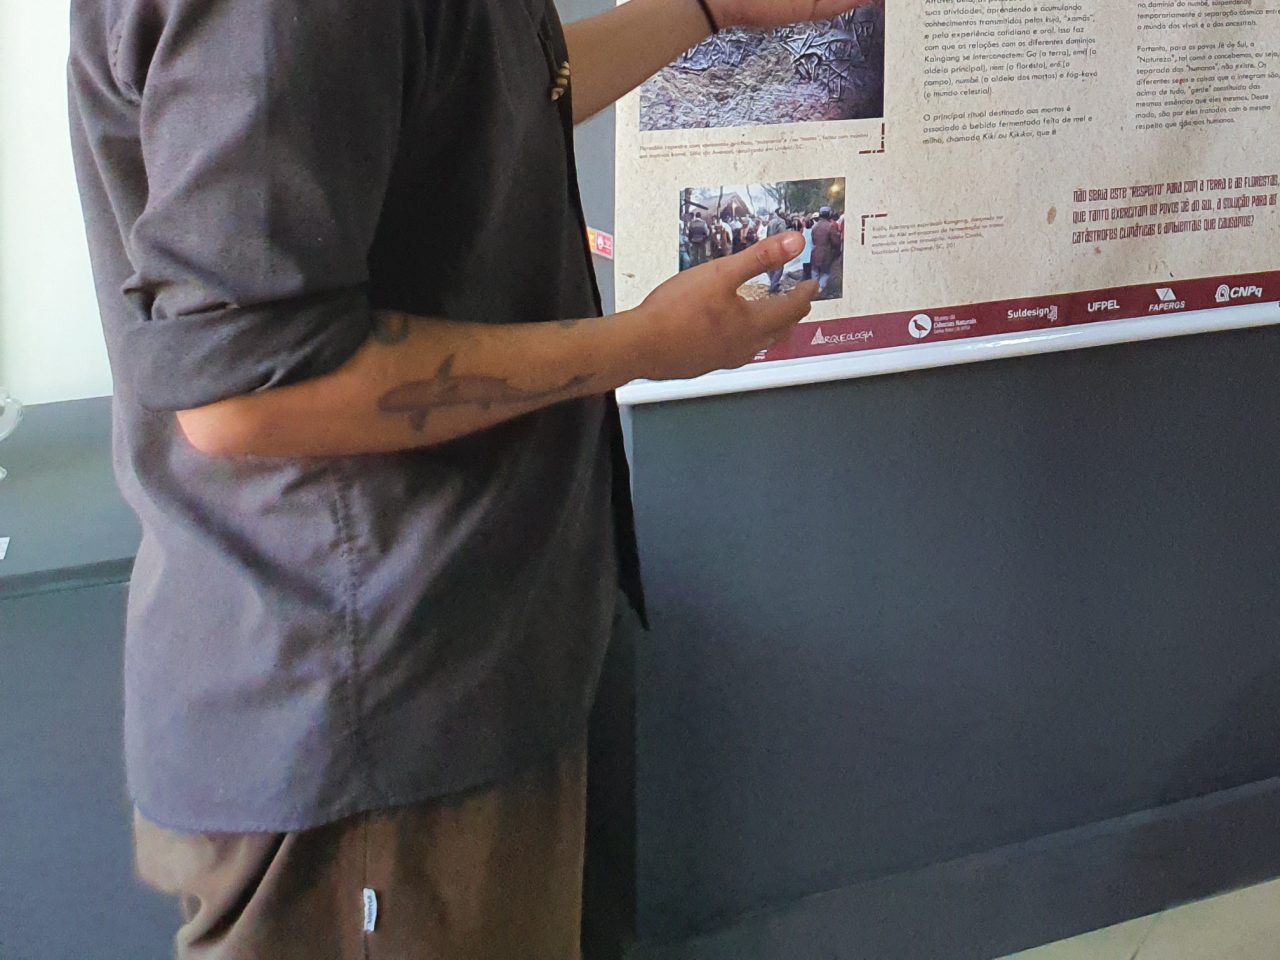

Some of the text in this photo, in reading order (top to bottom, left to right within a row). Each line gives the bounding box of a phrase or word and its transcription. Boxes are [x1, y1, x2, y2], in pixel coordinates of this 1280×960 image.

[1229, 285, 1262, 299] CNPq
[1087, 299, 1120, 312] UFPEL
[1149, 301, 1185, 311] FAPERGS
[1007, 307, 1050, 319] Suldesign
